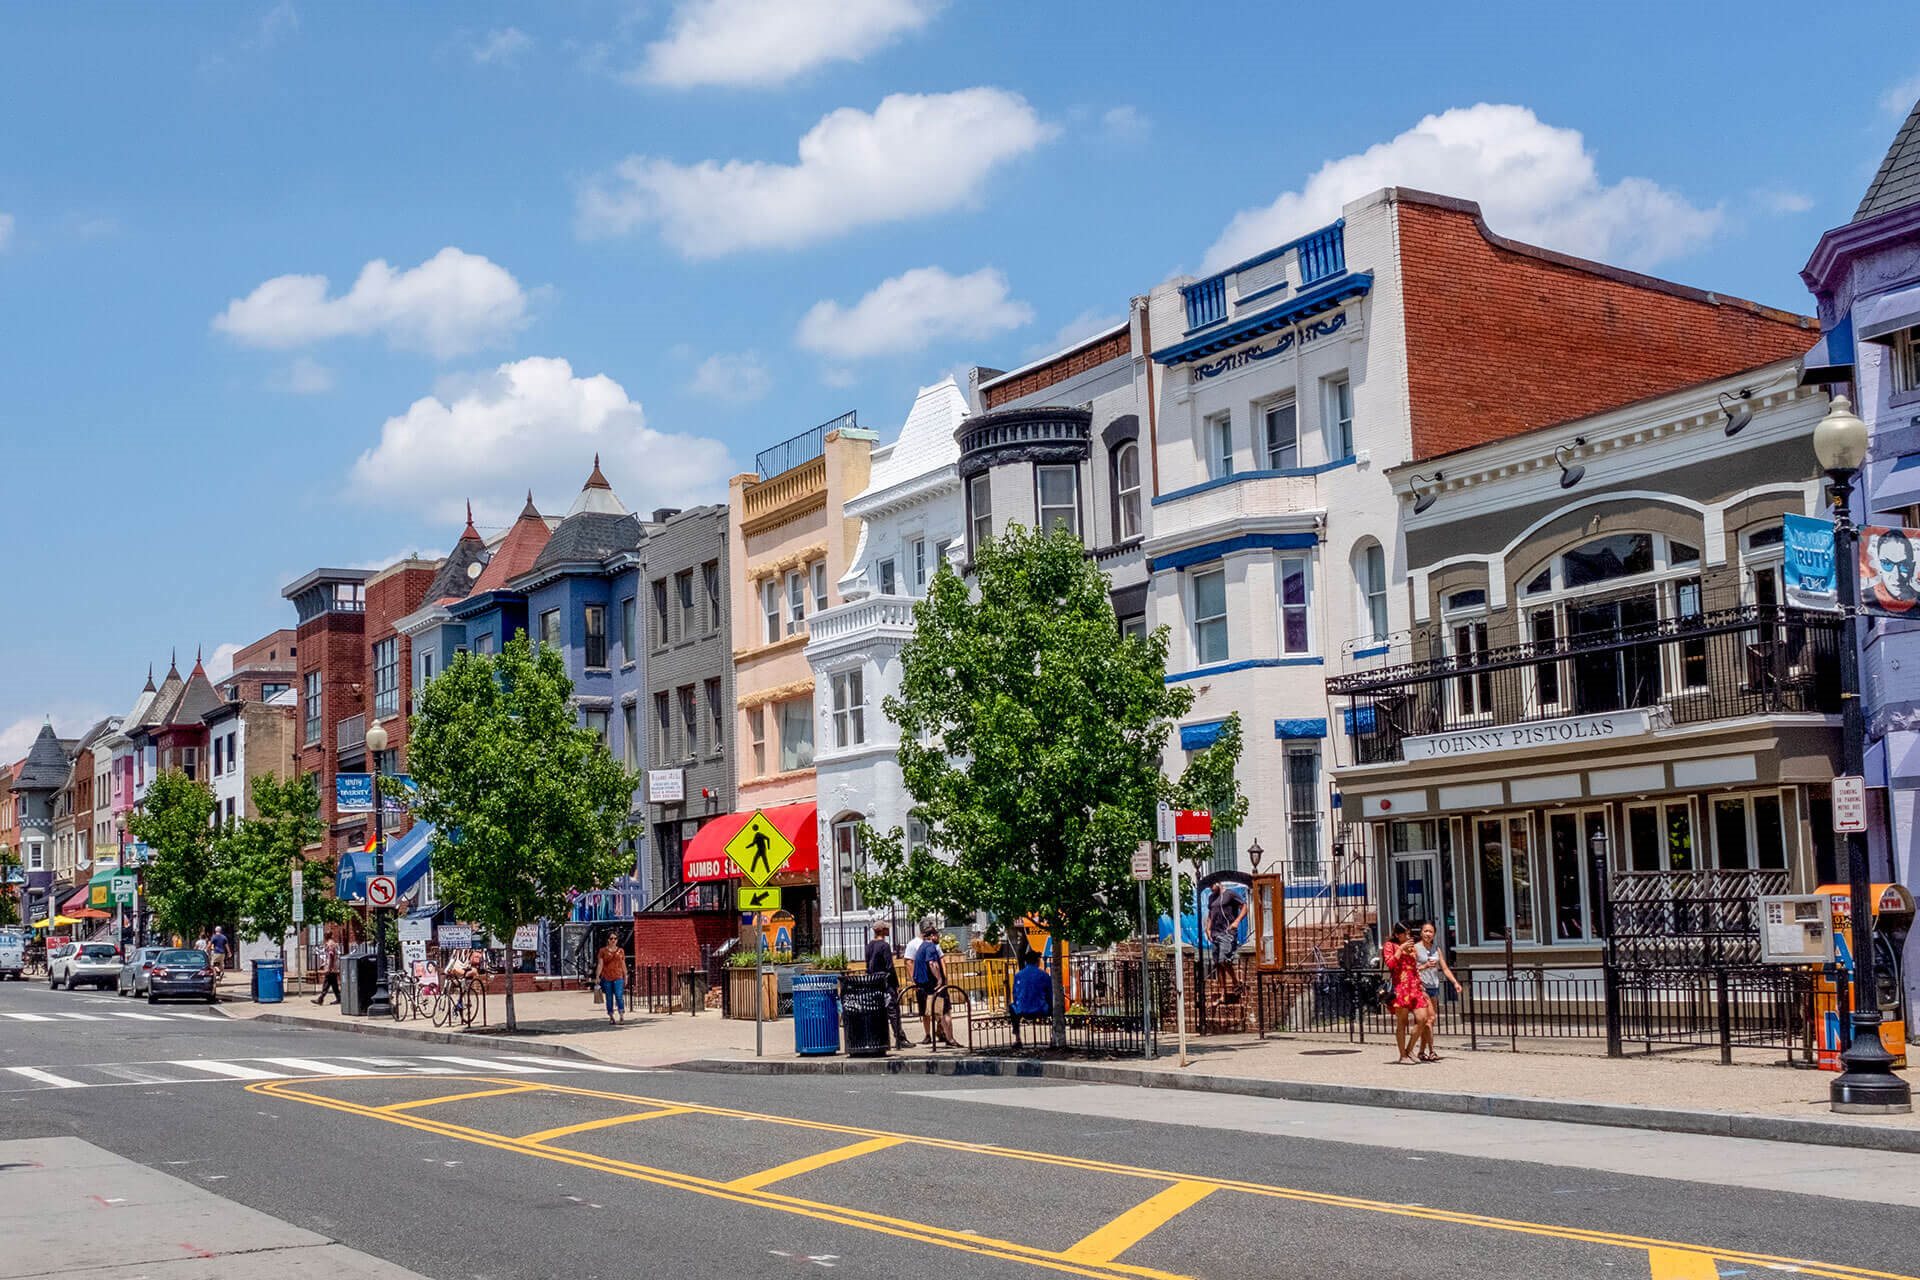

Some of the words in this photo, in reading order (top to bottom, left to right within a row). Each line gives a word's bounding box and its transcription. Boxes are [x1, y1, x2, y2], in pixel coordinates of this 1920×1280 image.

[1792, 545, 1831, 568] TRUTH
[1427, 732, 1503, 756] JOHNNY
[1512, 719, 1614, 745] PISTOLAS
[688, 860, 720, 878] JUMBO
